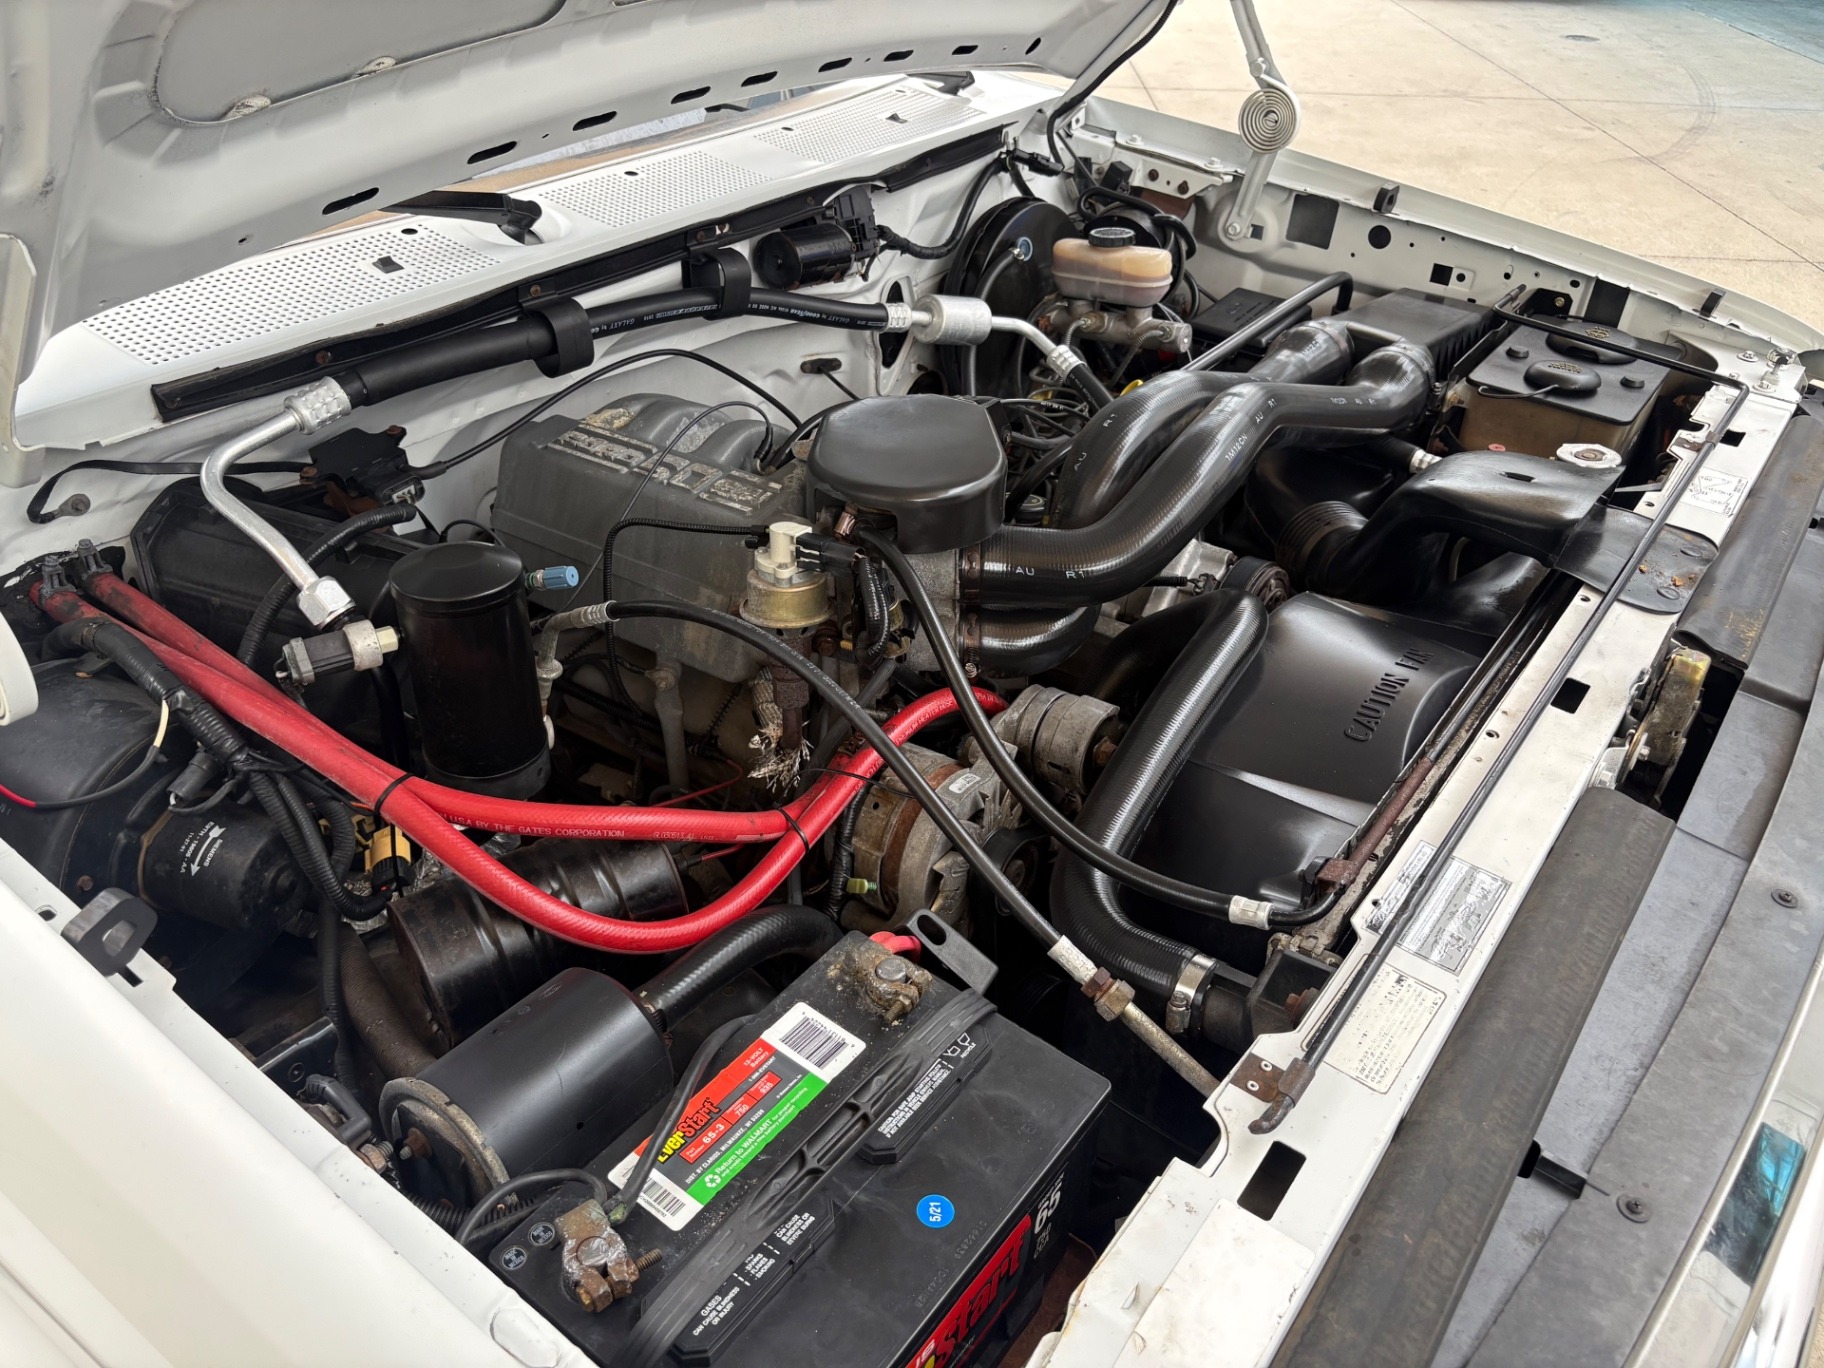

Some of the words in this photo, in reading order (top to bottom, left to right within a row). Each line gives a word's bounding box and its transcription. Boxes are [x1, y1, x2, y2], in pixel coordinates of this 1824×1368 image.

[1015, 566, 1035, 577] AU
[1065, 570, 1085, 579] R1
[1344, 672, 1410, 742] CAUTION
[1395, 647, 1435, 671] FAN
[450, 815, 472, 826] USA
[475, 820, 490, 829] BY
[494, 823, 515, 832] THE
[518, 826, 552, 835] GATES
[555, 828, 625, 838] CORPORATION
[203, 839, 223, 867] SIEMENS
[742, 1046, 763, 1067] 12-VOLT
[749, 1049, 769, 1068] Battery
[959, 1041, 977, 1058] RECYCLE
[759, 1080, 773, 1094] 935
[734, 1102, 749, 1117] 750
[701, 1121, 725, 1145] 65-3
[714, 1152, 736, 1174] Return
[734, 1145, 744, 1155] to
[740, 1118, 772, 1150] WALMART
[789, 1086, 808, 1104] recycling
[684, 1172, 697, 1185] DIST.
[695, 1165, 704, 1174] BY
[719, 1124, 747, 1152] MILWAUKEE,
[720, 1167, 730, 1177] and
[728, 1156, 741, 1170] credit
[739, 1144, 755, 1159] toward
[763, 1120, 779, 1136] battery
[929, 1202, 942, 1222] 5/21
[1034, 1181, 1062, 1234] 65
[532, 1225, 544, 1236] MADE
[775, 1226, 787, 1238] CAN
[784, 1213, 800, 1229] CAUSE
[780, 1218, 804, 1242] BLINDNESS
[800, 1211, 810, 1221] OR
[785, 1227, 803, 1246] SEVERE
[799, 1214, 815, 1231] BURNS
[504, 1248, 517, 1260] MADE
[744, 1251, 763, 1271] SPARKS
[749, 1256, 768, 1275] FLAMES
[754, 1257, 775, 1278] SMOKING
[692, 1323, 705, 1336] CAN
[701, 1309, 718, 1326] CAUSE
[714, 1285, 741, 1311] BLINDNESS
[699, 1294, 722, 1317] GASES
[710, 1315, 721, 1326] OR
[717, 1300, 735, 1318] INJURY
